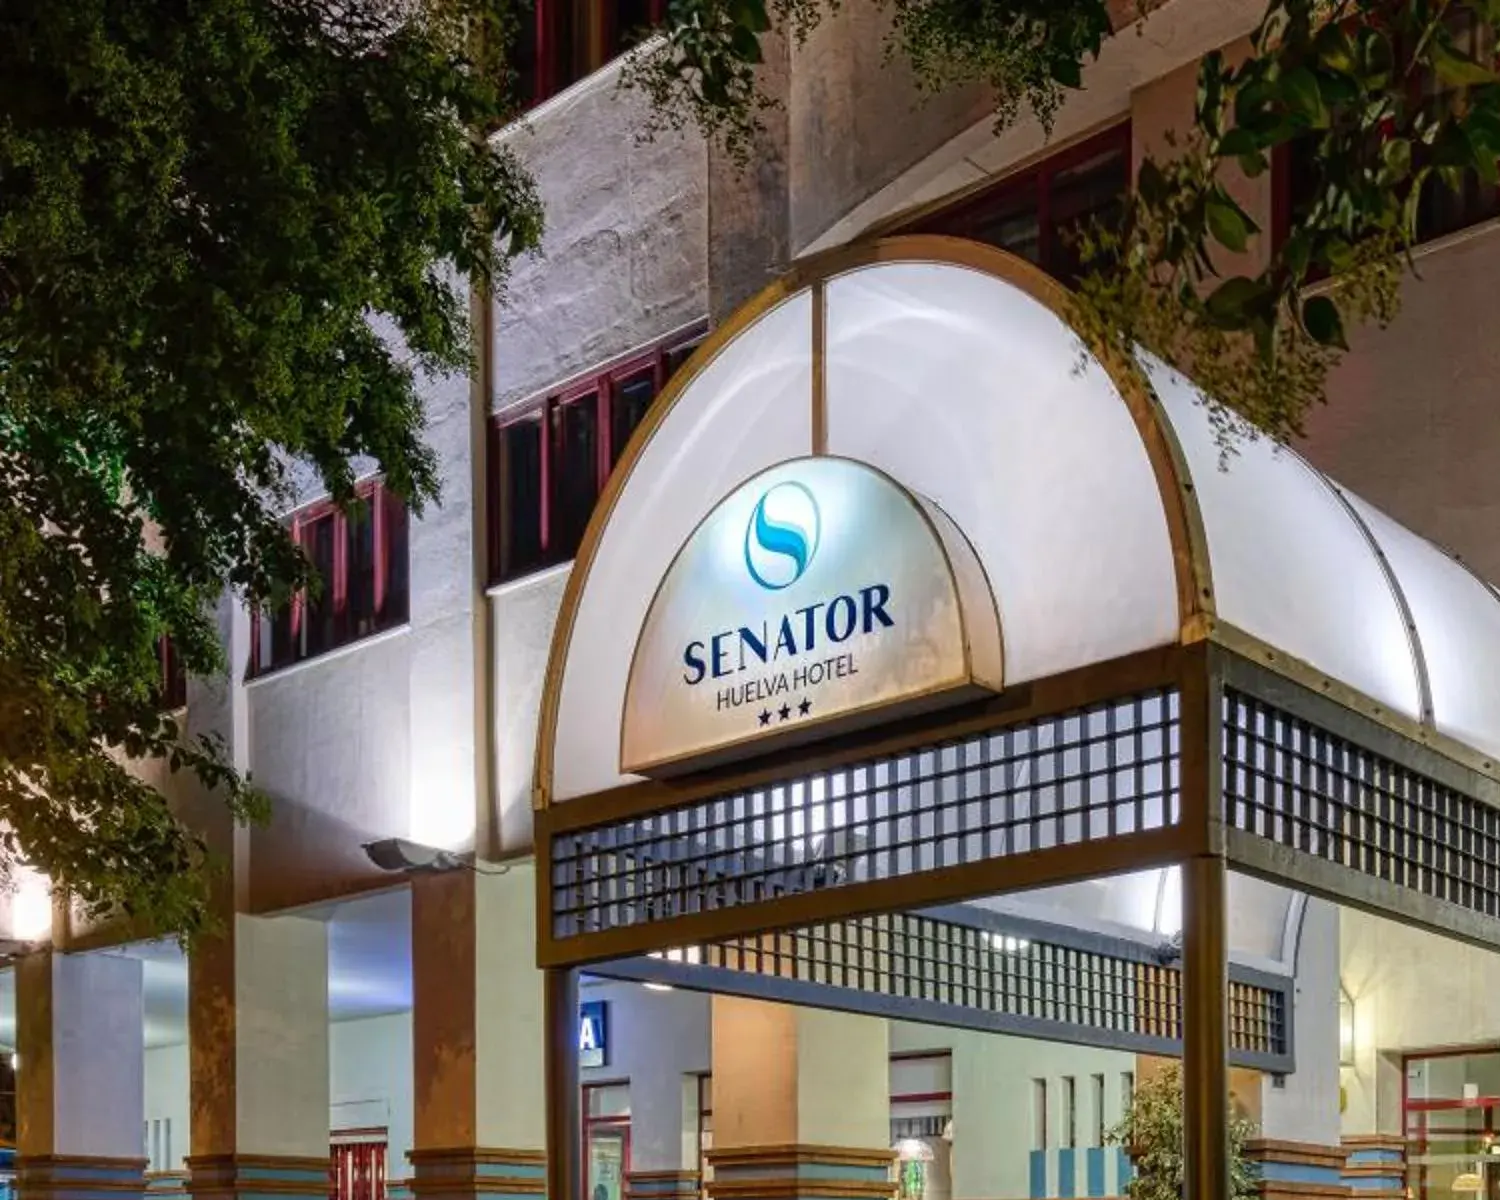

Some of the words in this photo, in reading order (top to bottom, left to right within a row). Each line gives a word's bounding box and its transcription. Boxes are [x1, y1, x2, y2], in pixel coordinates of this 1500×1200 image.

[683, 584, 895, 685] SENATOR
[716, 674, 789, 711] HUELVA
[793, 653, 858, 690] HOTEL
